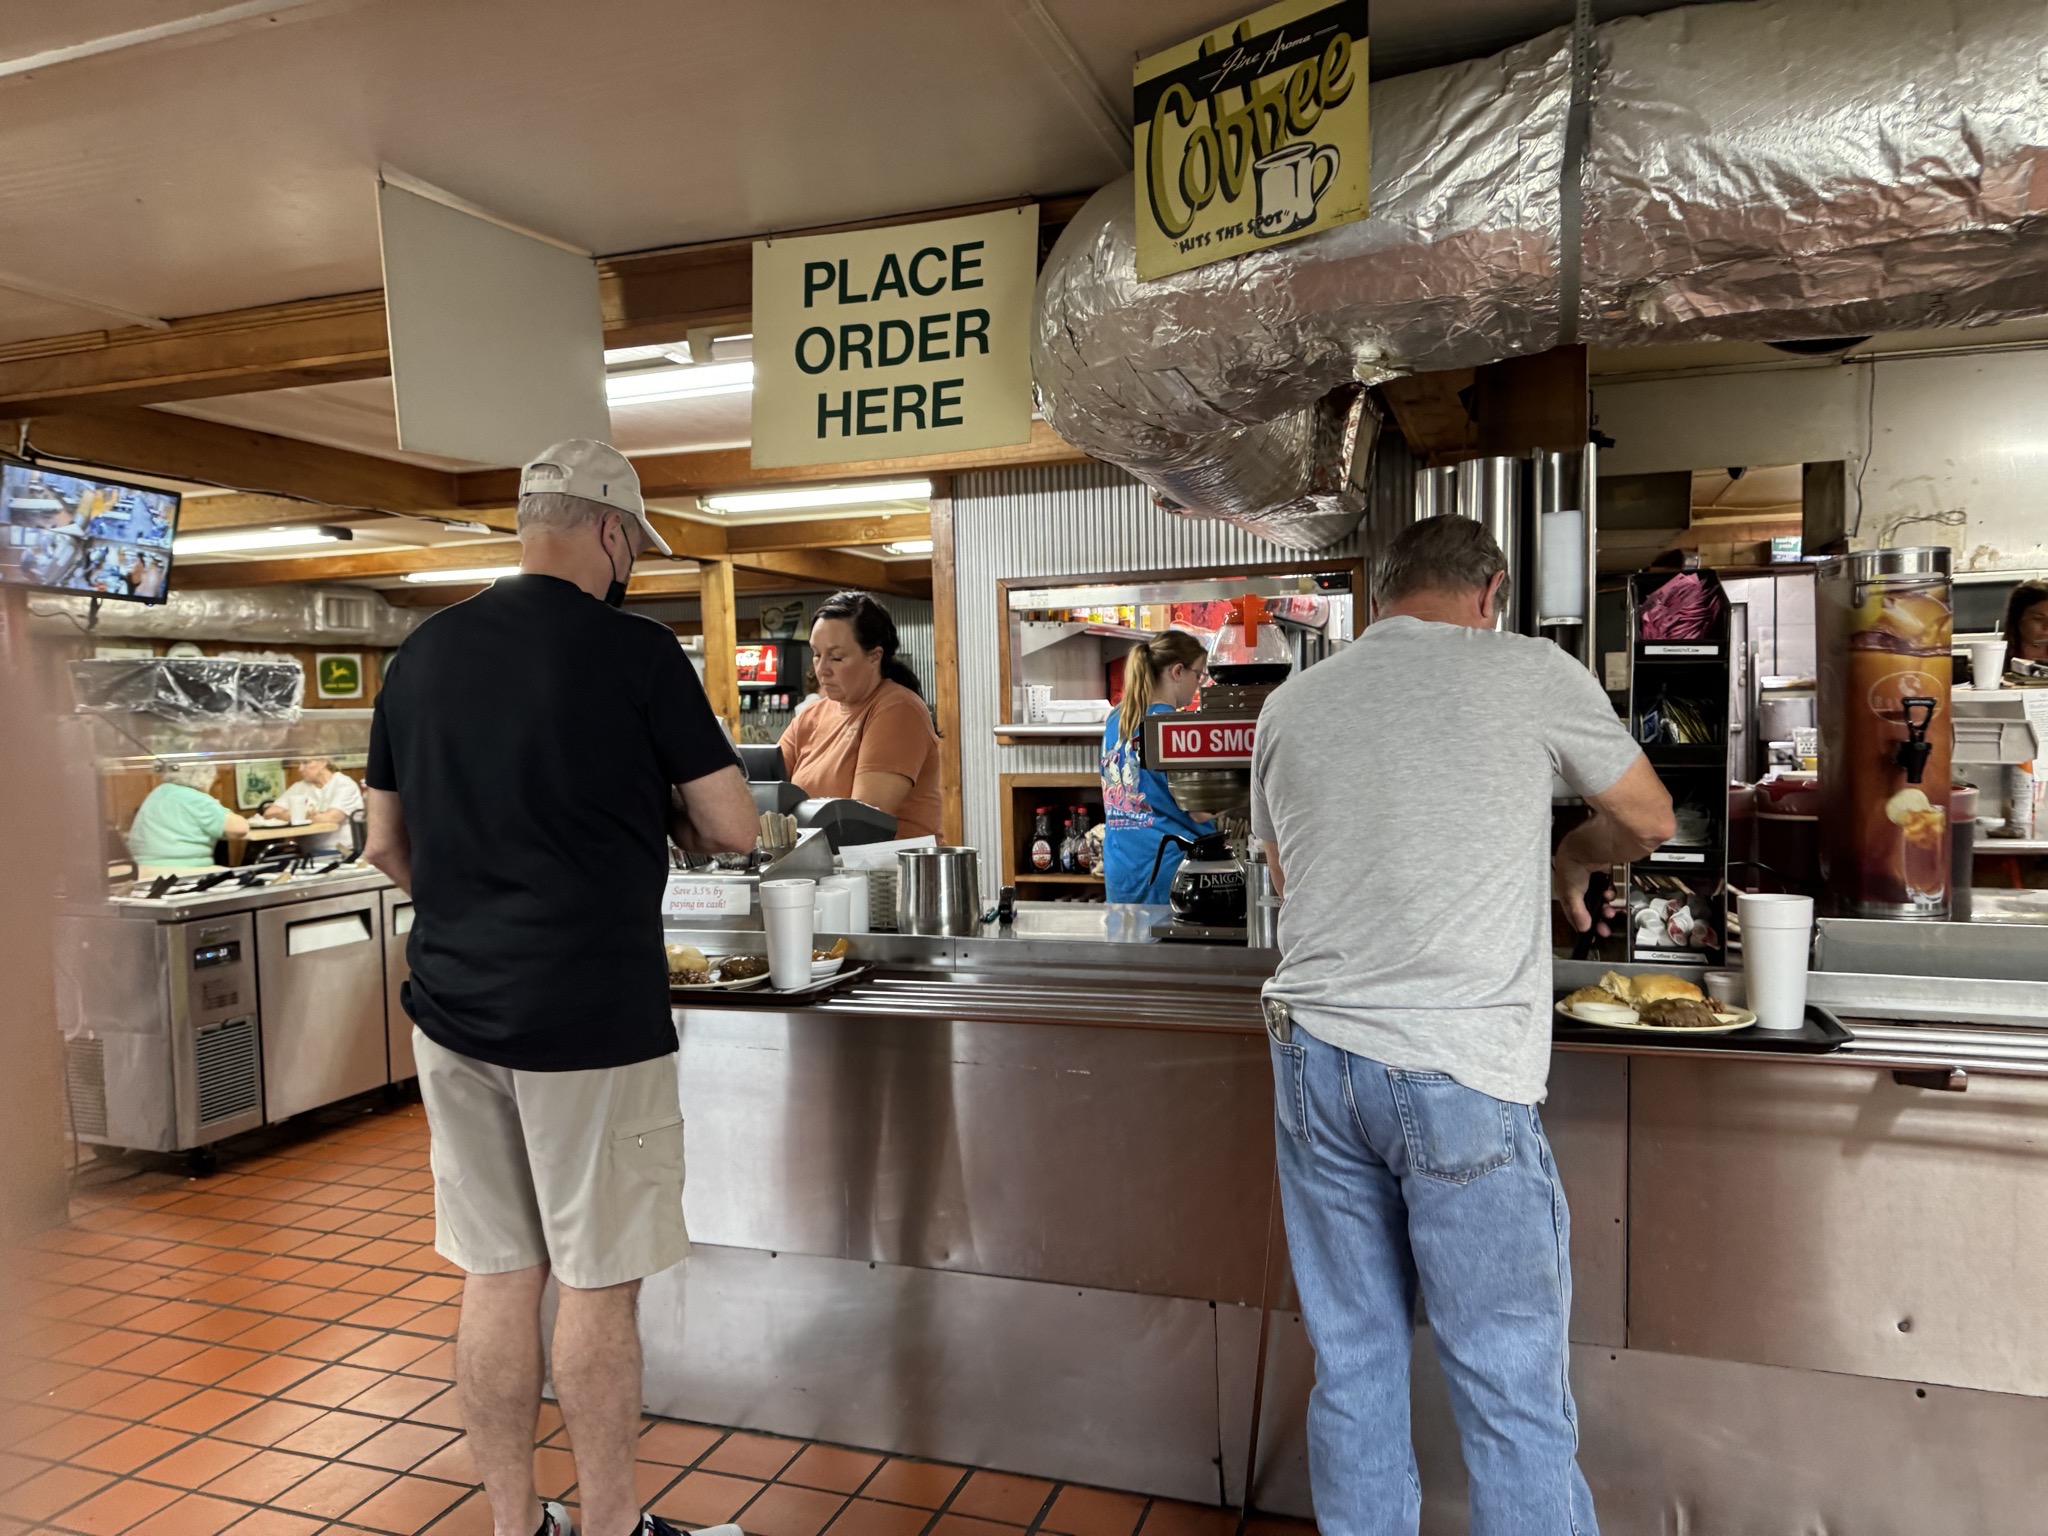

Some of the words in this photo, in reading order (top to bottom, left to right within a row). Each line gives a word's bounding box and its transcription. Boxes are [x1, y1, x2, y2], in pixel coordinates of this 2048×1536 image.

[1211, 46, 1261, 93] Fine
[1257, 30, 1313, 74] Aroma
[1147, 20, 1355, 240] Coffee
[1215, 221, 1244, 242] THE
[804, 240, 985, 309] PLACE
[794, 308, 991, 375] ORDER
[817, 378, 964, 439] HERE
[1171, 729, 1202, 753] NO
[669, 899, 695, 911] paying
[696, 900, 705, 908] in
[706, 899, 727, 908] cash!
[672, 886, 692, 896] Save
[692, 886, 712, 896] 3.5%
[713, 886, 723, 898] by
[1651, 952, 1671, 960] Coffee
